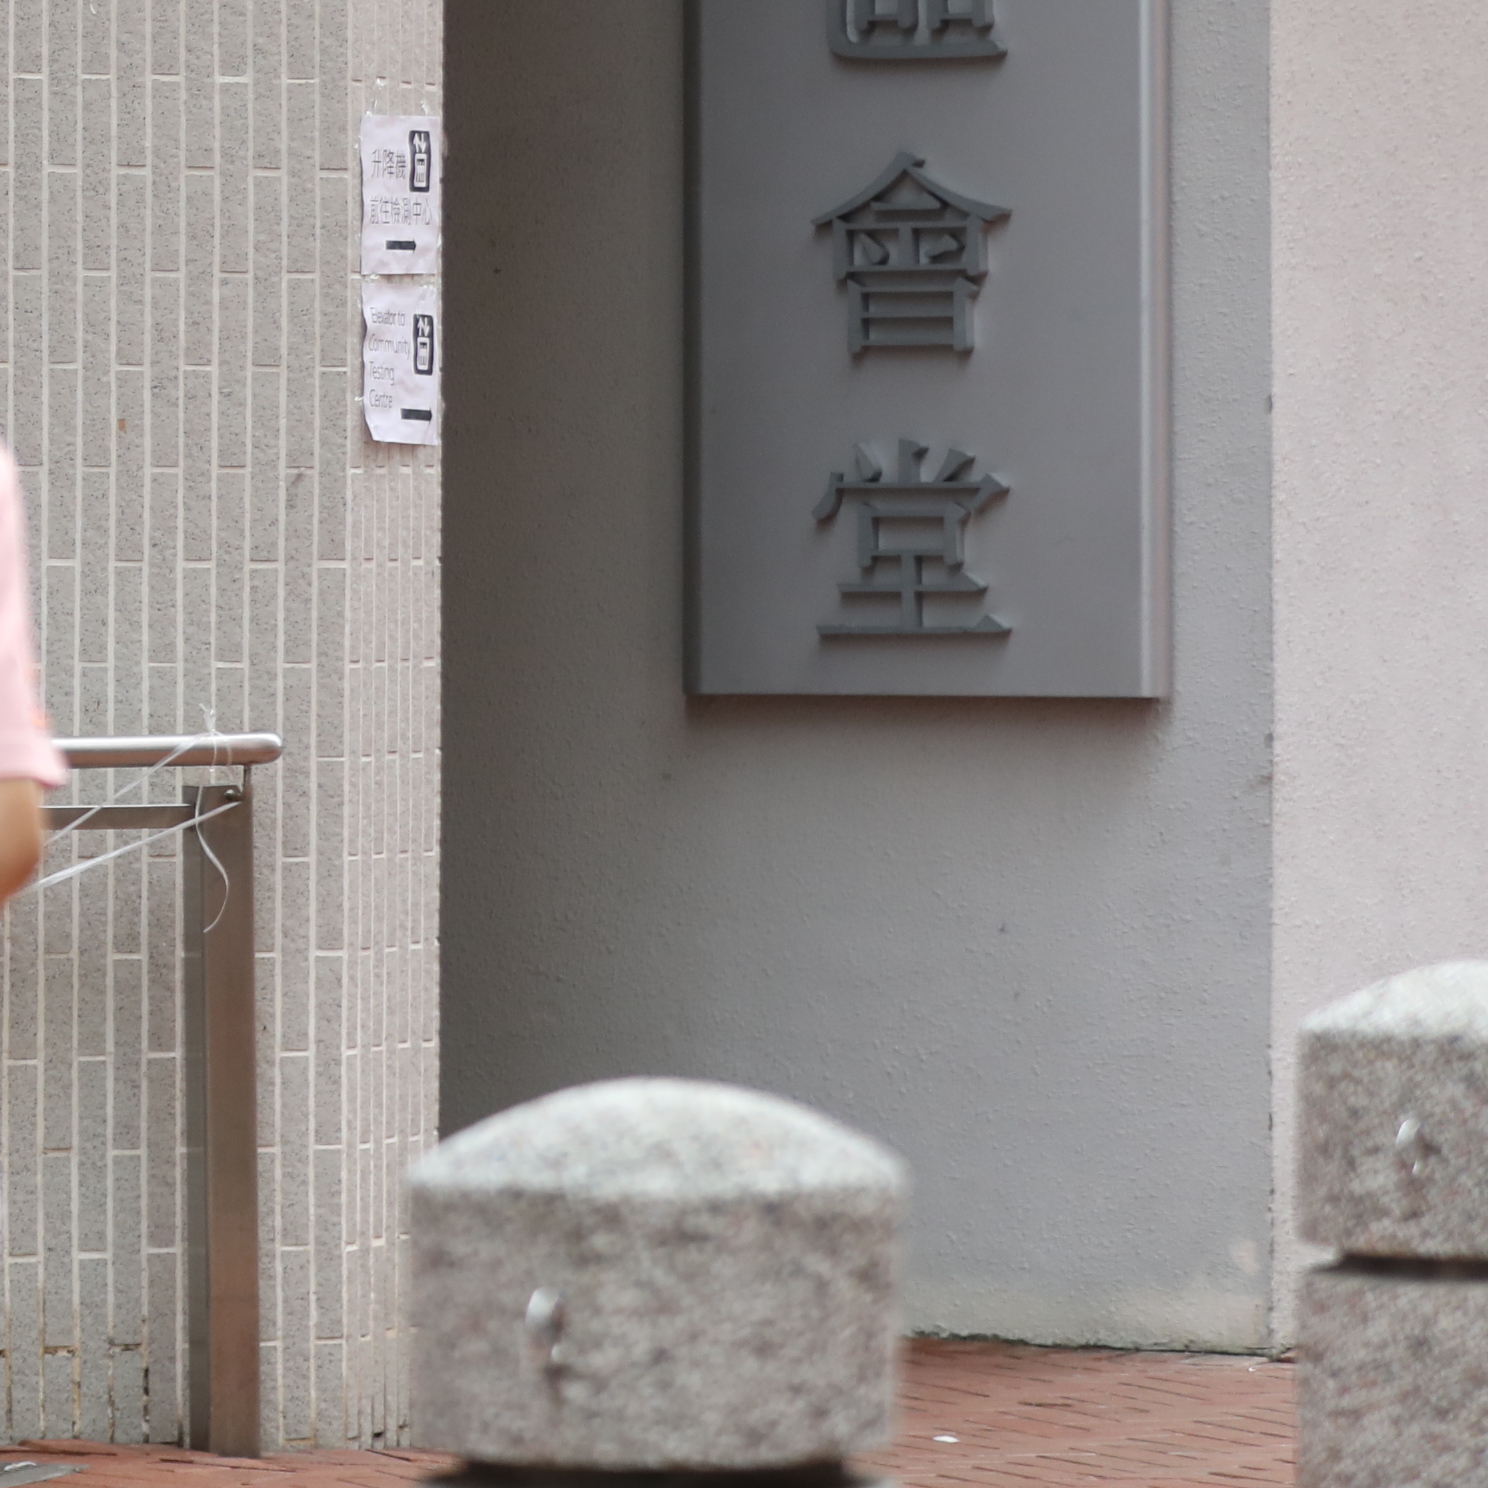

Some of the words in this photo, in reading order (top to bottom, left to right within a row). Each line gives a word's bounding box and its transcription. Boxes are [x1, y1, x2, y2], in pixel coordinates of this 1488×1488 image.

[370, 148, 407, 180] 升降機
[369, 195, 433, 226] 前往檢測中心
[368, 333, 411, 360] Community
[369, 360, 396, 386] Testing
[368, 388, 393, 409] Centre
